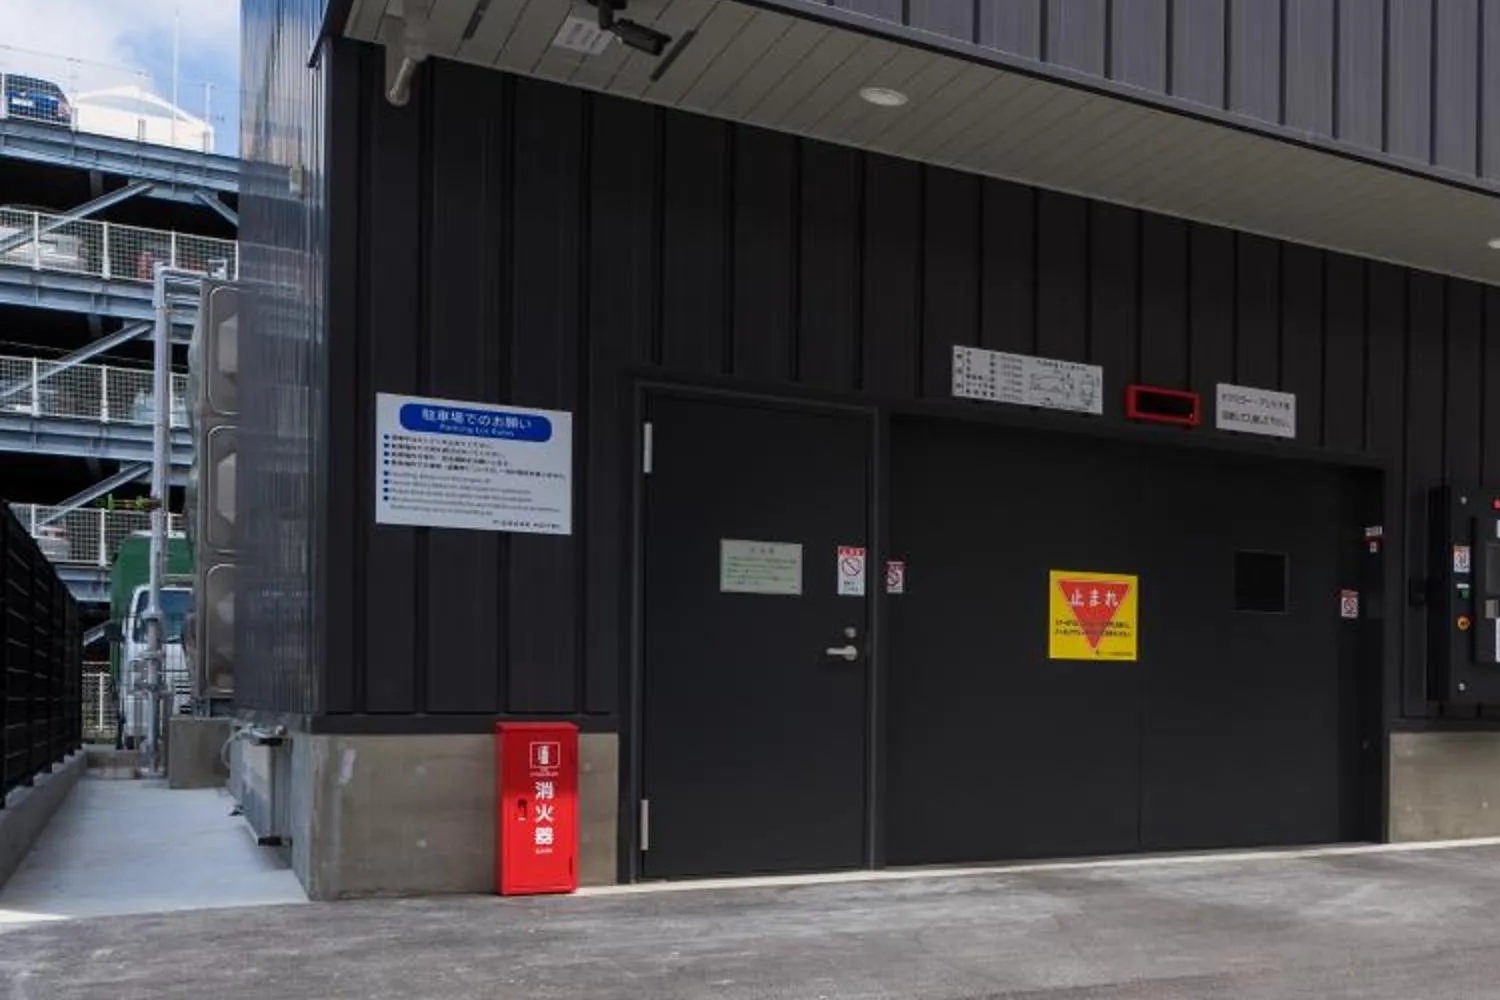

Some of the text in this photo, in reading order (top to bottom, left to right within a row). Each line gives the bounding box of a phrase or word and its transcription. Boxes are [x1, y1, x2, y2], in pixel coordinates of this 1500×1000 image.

[420, 407, 533, 430] 駐車場でのお願い
[1065, 587, 1121, 609] 止まれ
[535, 781, 554, 846] 消火器
